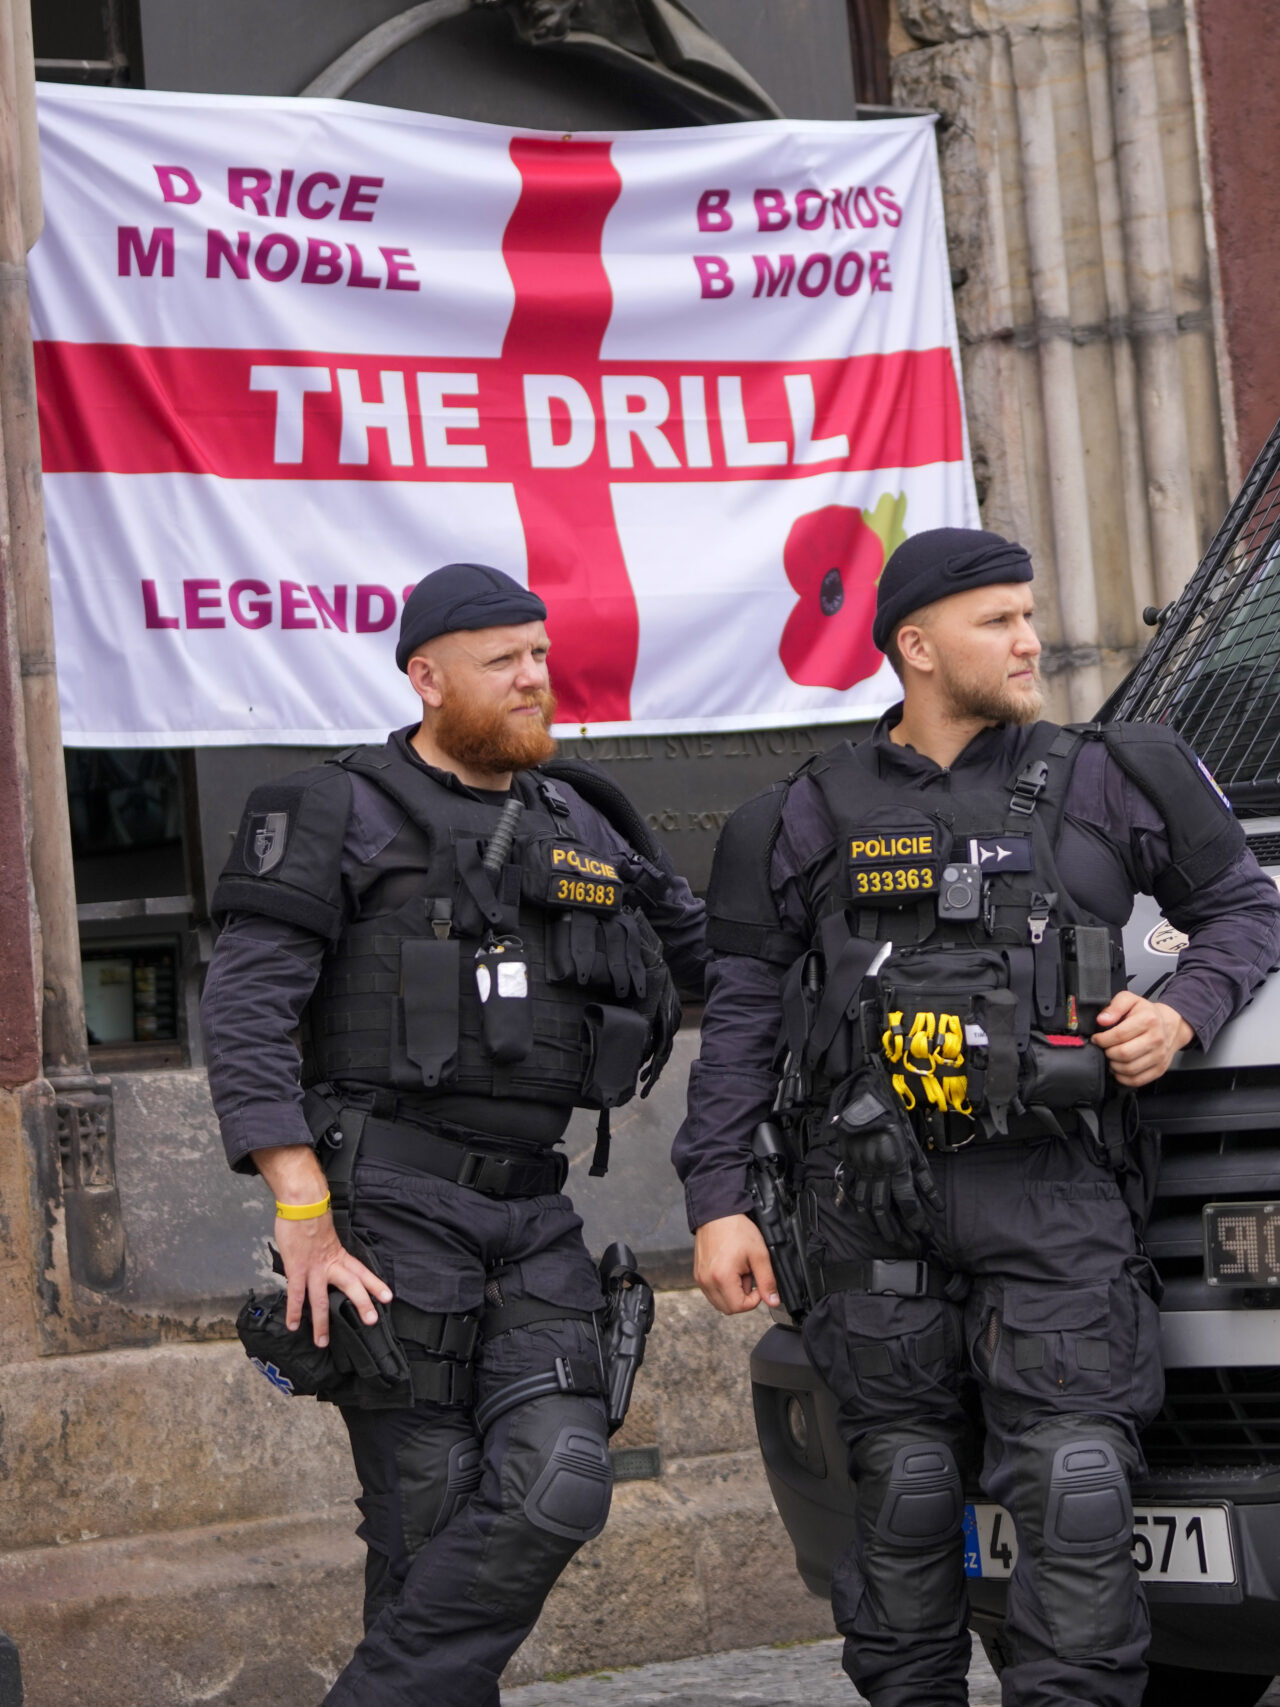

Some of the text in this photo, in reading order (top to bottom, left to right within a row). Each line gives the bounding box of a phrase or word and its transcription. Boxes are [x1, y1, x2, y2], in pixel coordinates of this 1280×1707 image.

[153, 164, 384, 223] D RICE
[697, 188, 734, 232] B
[117, 226, 421, 292] M NOBLE
[692, 255, 735, 299] B
[249, 364, 850, 469] THE DRILL
[552, 848, 618, 880] POLICIE
[852, 836, 933, 858] POLICIE
[557, 879, 615, 906] 316383
[856, 867, 934, 894] 333363
[1132, 1515, 1208, 1574] 571
